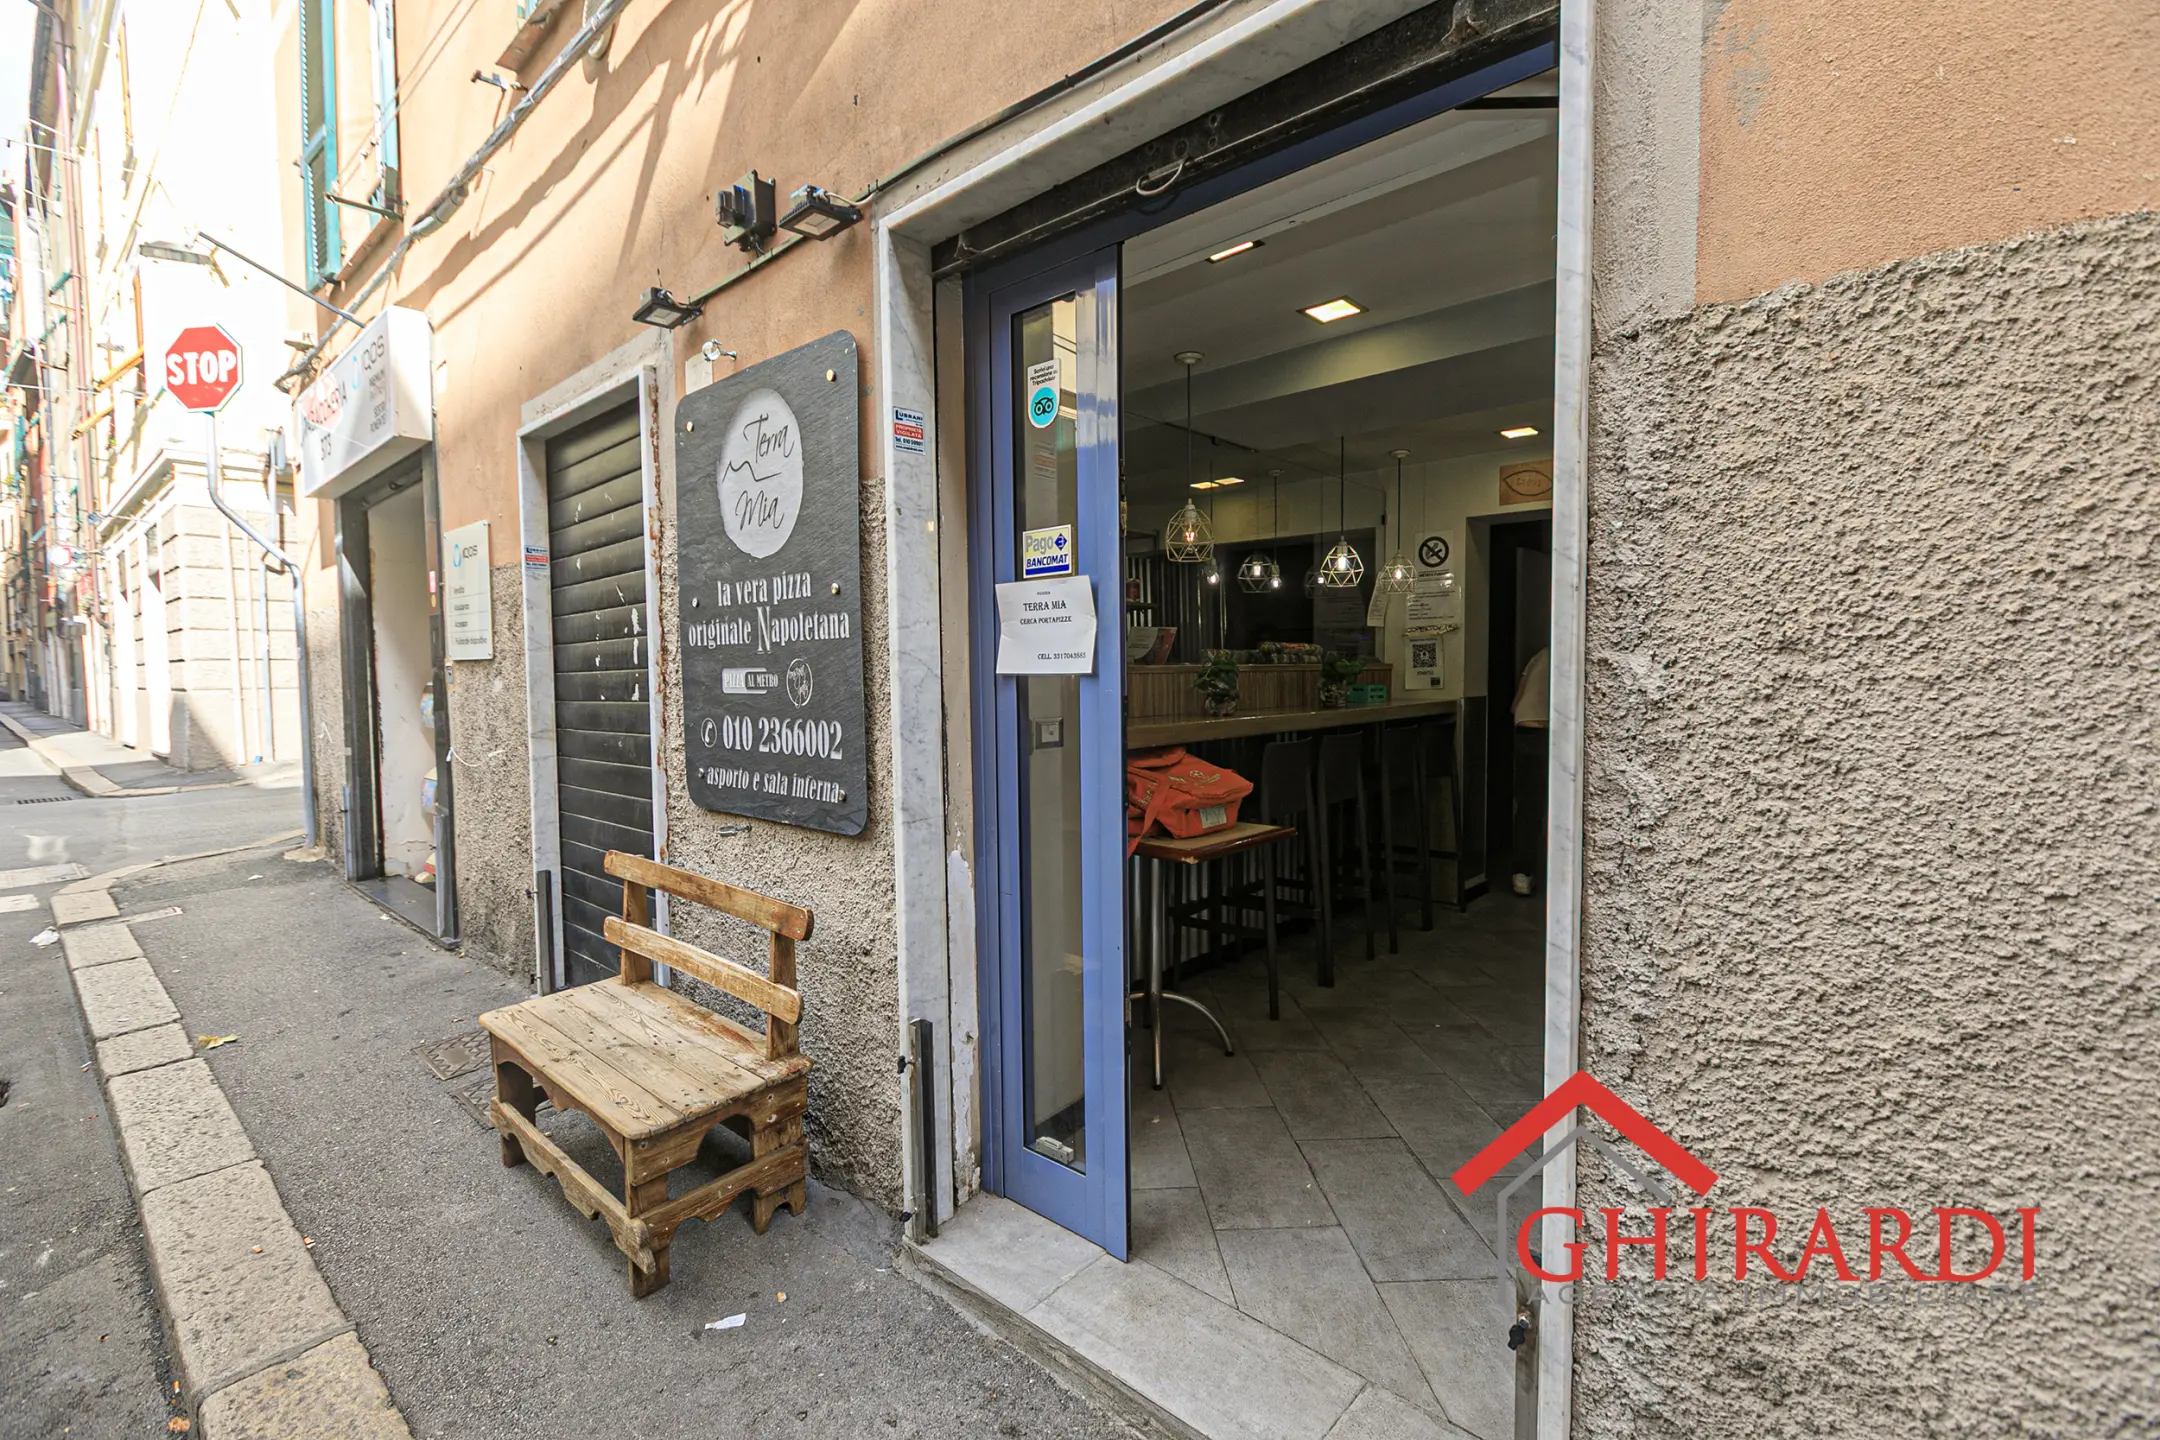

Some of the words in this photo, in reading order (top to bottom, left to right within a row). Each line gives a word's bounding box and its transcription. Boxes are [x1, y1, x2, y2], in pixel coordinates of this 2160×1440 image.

[166, 349, 237, 386] STOP
[743, 413, 795, 463] Terra
[735, 490, 785, 530] Mia
[1025, 535, 1054, 555] Pago
[1026, 553, 1069, 568] BANCOMAT
[717, 580, 731, 606] la
[736, 577, 768, 605] vera
[772, 571, 812, 605] pizza
[1023, 601, 1050, 612] TERRA
[1051, 600, 1067, 610] MIA
[688, 617, 752, 650] originale
[756, 606, 850, 655] Napoletana
[1038, 616, 1072, 624] PORTAPIZZE
[724, 673, 745, 688] PIZZA
[747, 674, 755, 687] AL
[757, 673, 779, 688] METRO
[722, 715, 753, 751] 010
[758, 716, 843, 760] 2366002
[706, 766, 750, 789] asporto
[753, 771, 760, 791] e
[763, 771, 789, 796] sala
[791, 772, 839, 804] interna
